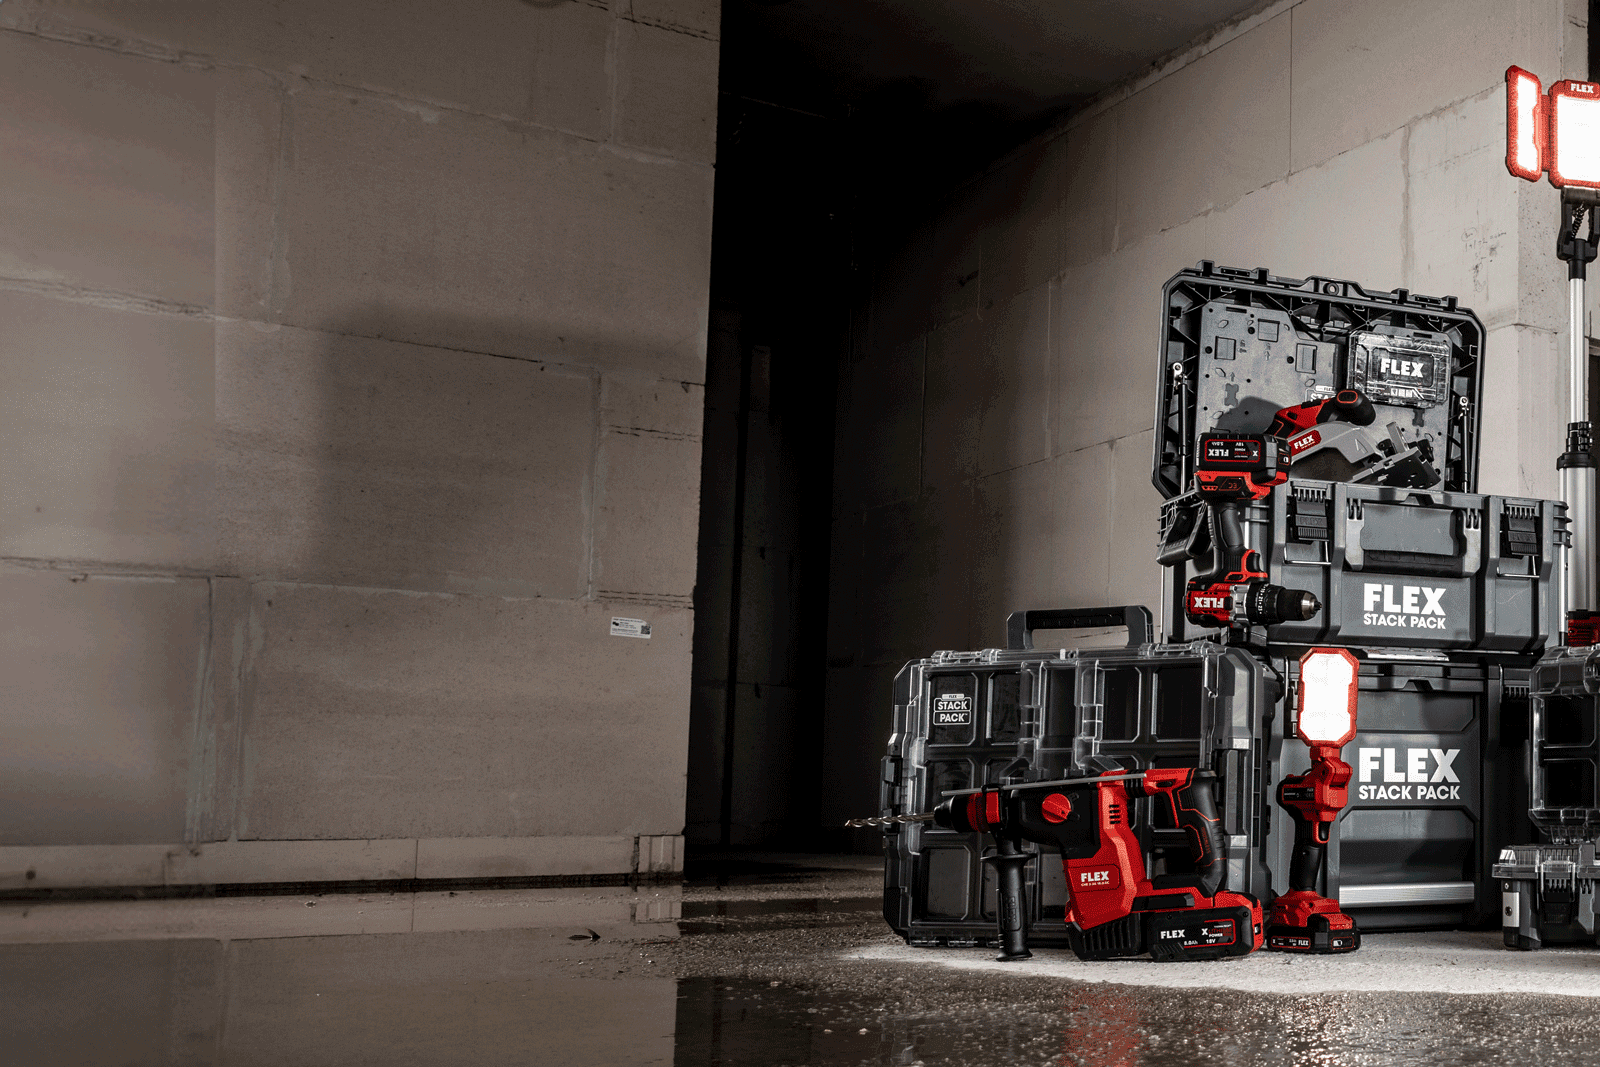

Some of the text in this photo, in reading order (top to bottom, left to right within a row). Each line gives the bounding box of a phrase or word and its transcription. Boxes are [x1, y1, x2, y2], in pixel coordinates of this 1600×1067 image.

[1571, 83, 1593, 93] FLEX
[1380, 357, 1424, 378] FLEX
[1294, 435, 1314, 449] FLEX
[1194, 597, 1224, 608] FLEX
[1363, 583, 1446, 616] FLEX
[1363, 613, 1446, 629] STACK PACK
[938, 701, 968, 710] STACK
[1359, 748, 1460, 782] FLEX
[1359, 785, 1460, 800] STACK PACK
[1081, 871, 1109, 882] FLEX
[1160, 929, 1185, 939] FLEX
